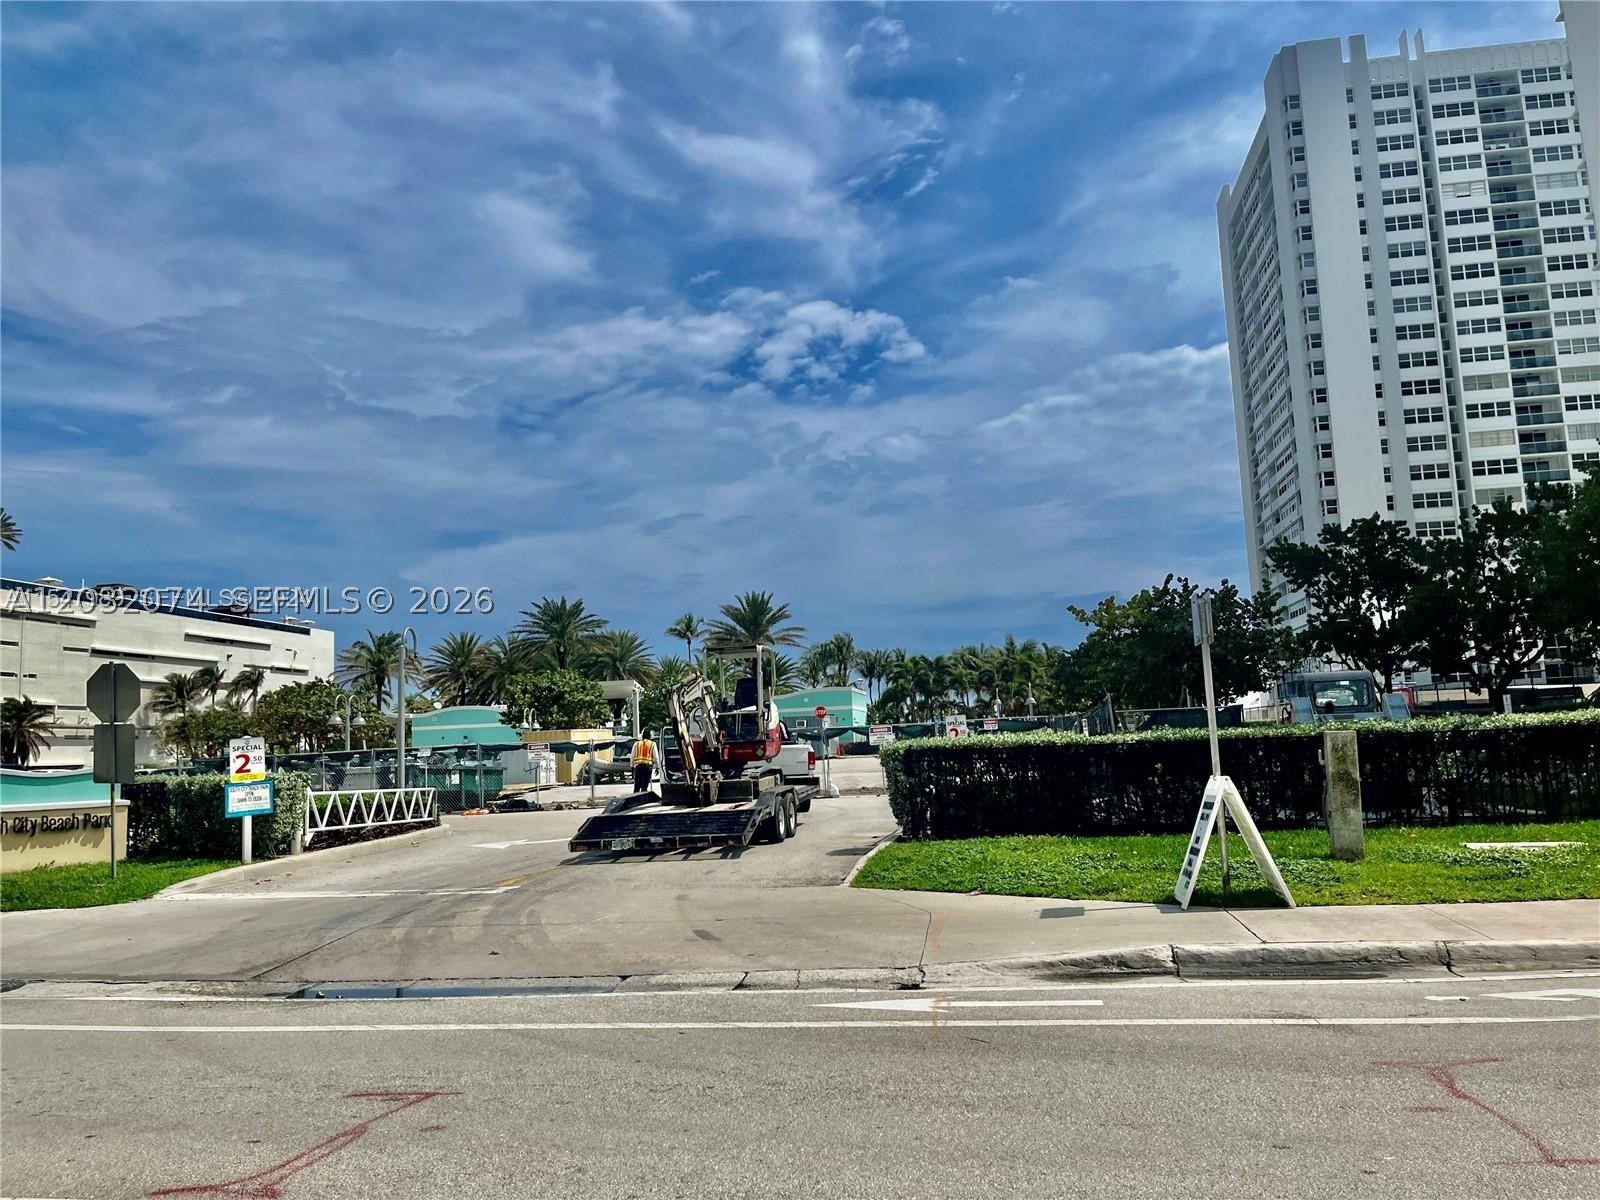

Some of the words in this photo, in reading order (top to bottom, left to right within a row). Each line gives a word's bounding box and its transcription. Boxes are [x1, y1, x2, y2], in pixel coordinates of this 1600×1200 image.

[232, 744, 263, 752] SPECIAL
[13, 816, 38, 838] City
[41, 813, 79, 832] Beach
